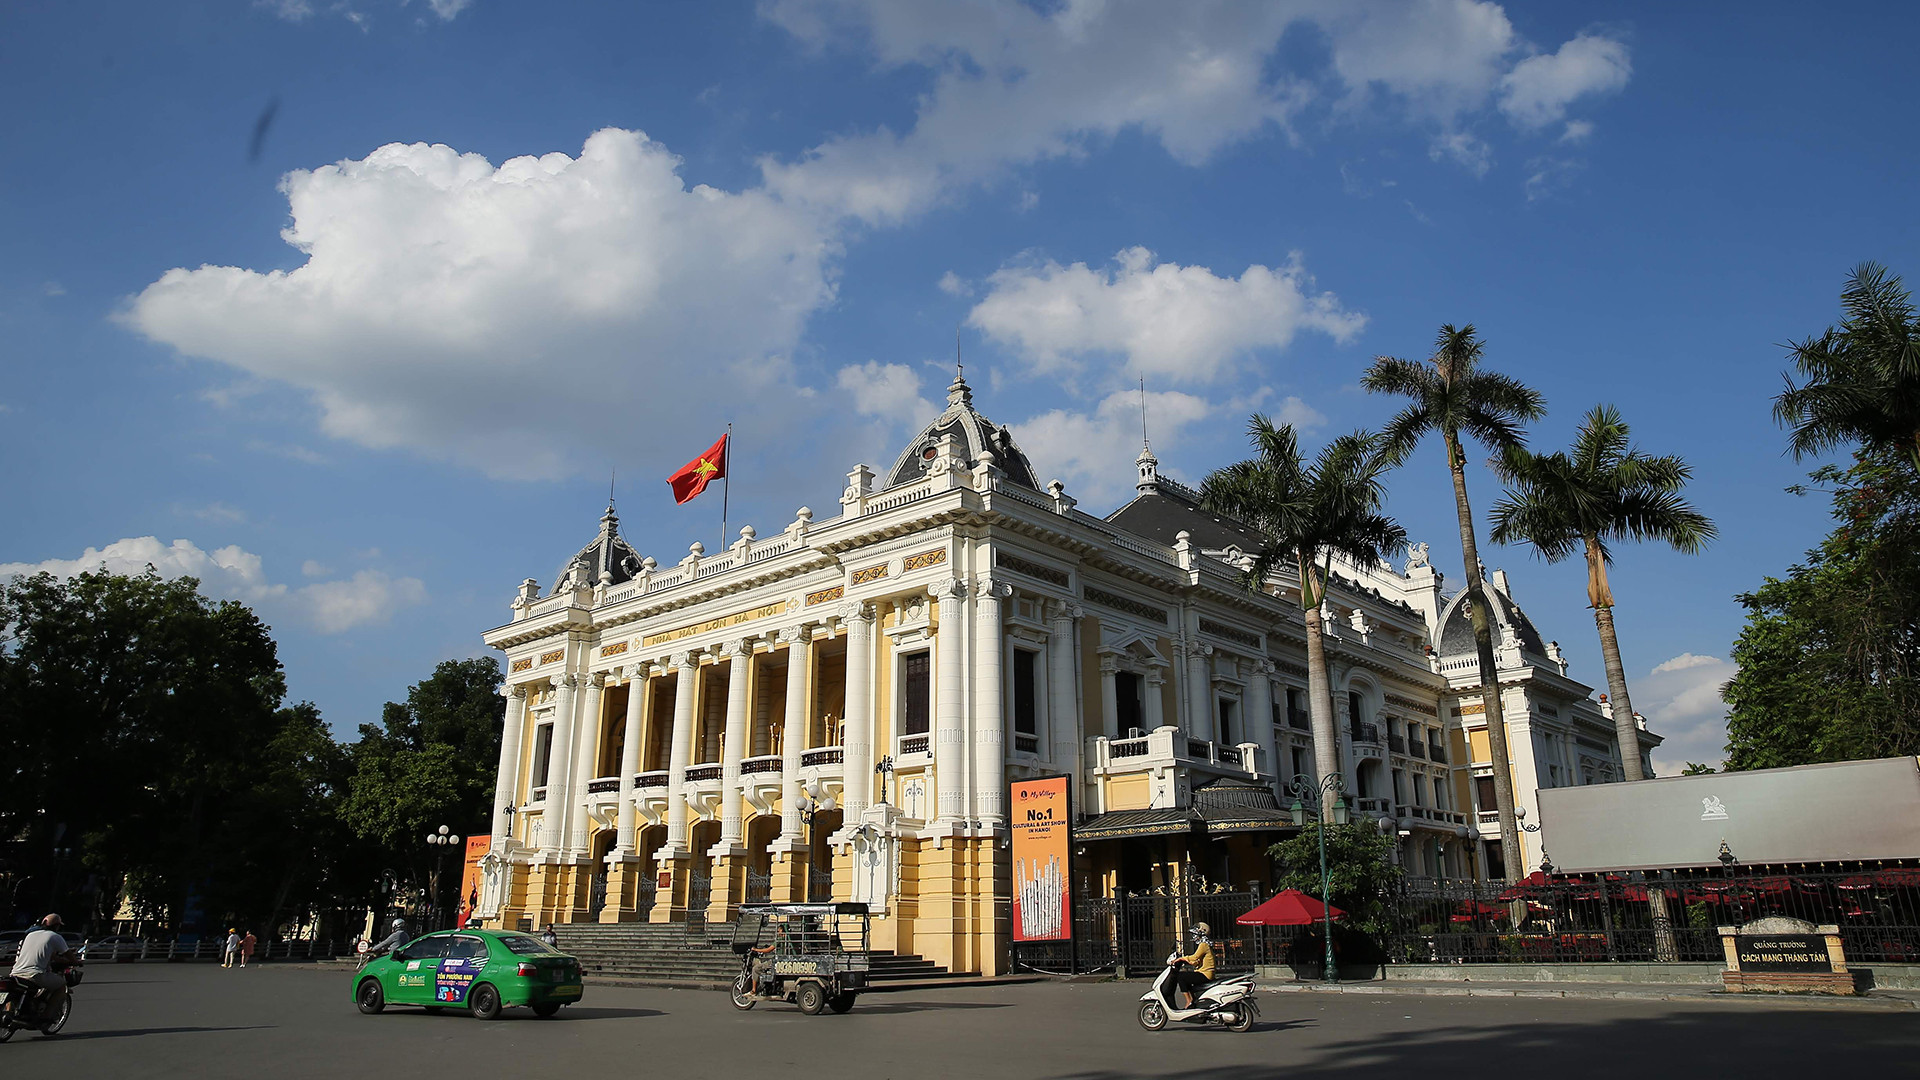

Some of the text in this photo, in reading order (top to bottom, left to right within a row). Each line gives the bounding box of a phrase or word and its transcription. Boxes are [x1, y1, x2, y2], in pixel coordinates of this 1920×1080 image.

[1027, 808, 1053, 821] No.1
[1741, 952, 1761, 962] CÁCH
[1783, 951, 1809, 962] THÁNG
[1809, 951, 1827, 962] TÁM
